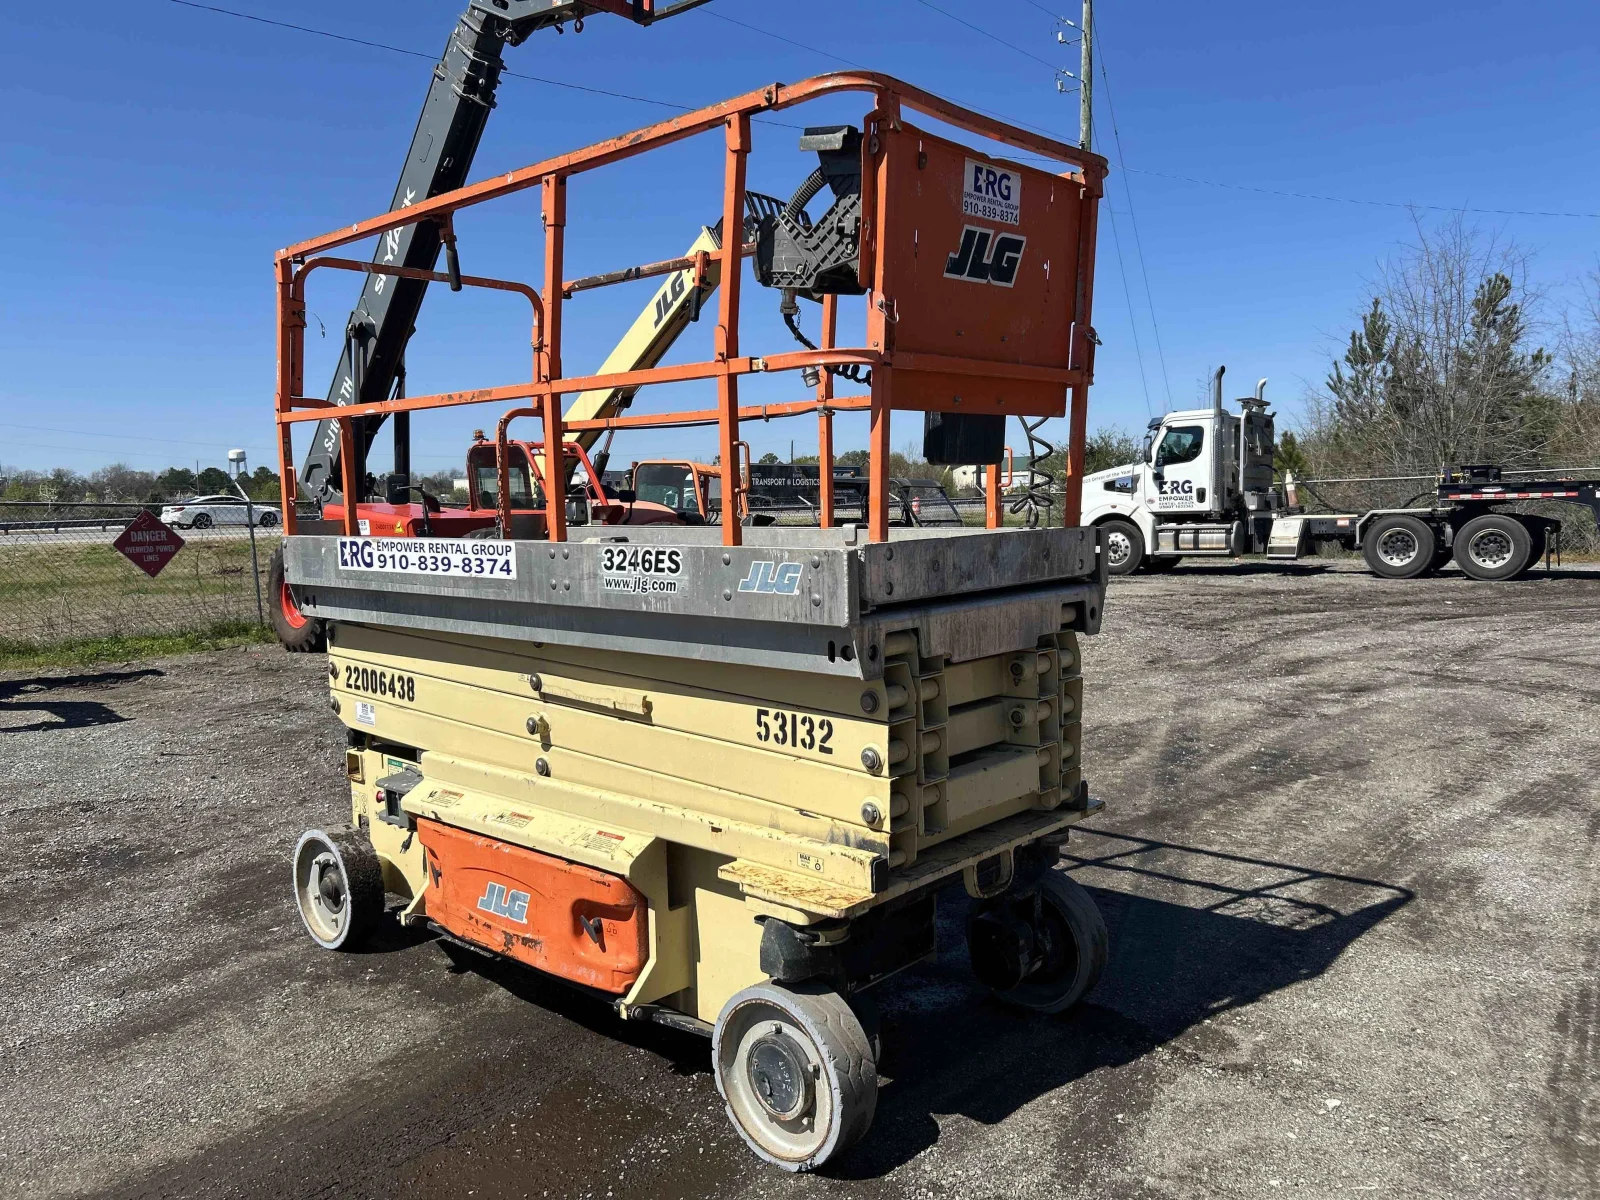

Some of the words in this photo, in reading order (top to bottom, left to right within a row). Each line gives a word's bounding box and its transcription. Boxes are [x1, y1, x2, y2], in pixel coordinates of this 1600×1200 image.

[974, 165, 1011, 200] ERG
[964, 191, 987, 203] EMPOWER
[987, 197, 1003, 208] RENTAL
[1004, 202, 1019, 211] GROUP
[964, 201, 1018, 224] 910-839-8374
[943, 224, 1026, 288] JLG
[654, 270, 685, 329] JLG
[340, 376, 353, 399] TH
[751, 478, 786, 486] TRANSPORT
[792, 478, 820, 486] LOGISTICS
[1159, 480, 1192, 494] ERG
[130, 531, 167, 542] DANGER
[125, 546, 154, 554] OVERHEAD
[156, 545, 176, 553] POWER
[143, 554, 159, 562] LINES
[340, 540, 374, 568] ERG
[376, 541, 426, 553] EMPOWER
[428, 543, 468, 555] RENTAL
[471, 544, 512, 556] GROUP
[378, 553, 512, 576] 910-839-8374
[602, 547, 682, 574] 3246ES
[604, 577, 677, 593] www.jlg.com
[738, 561, 803, 595] JLG
[345, 665, 415, 702] 22006438
[756, 708, 833, 755] 53132
[477, 881, 531, 924] JLG
